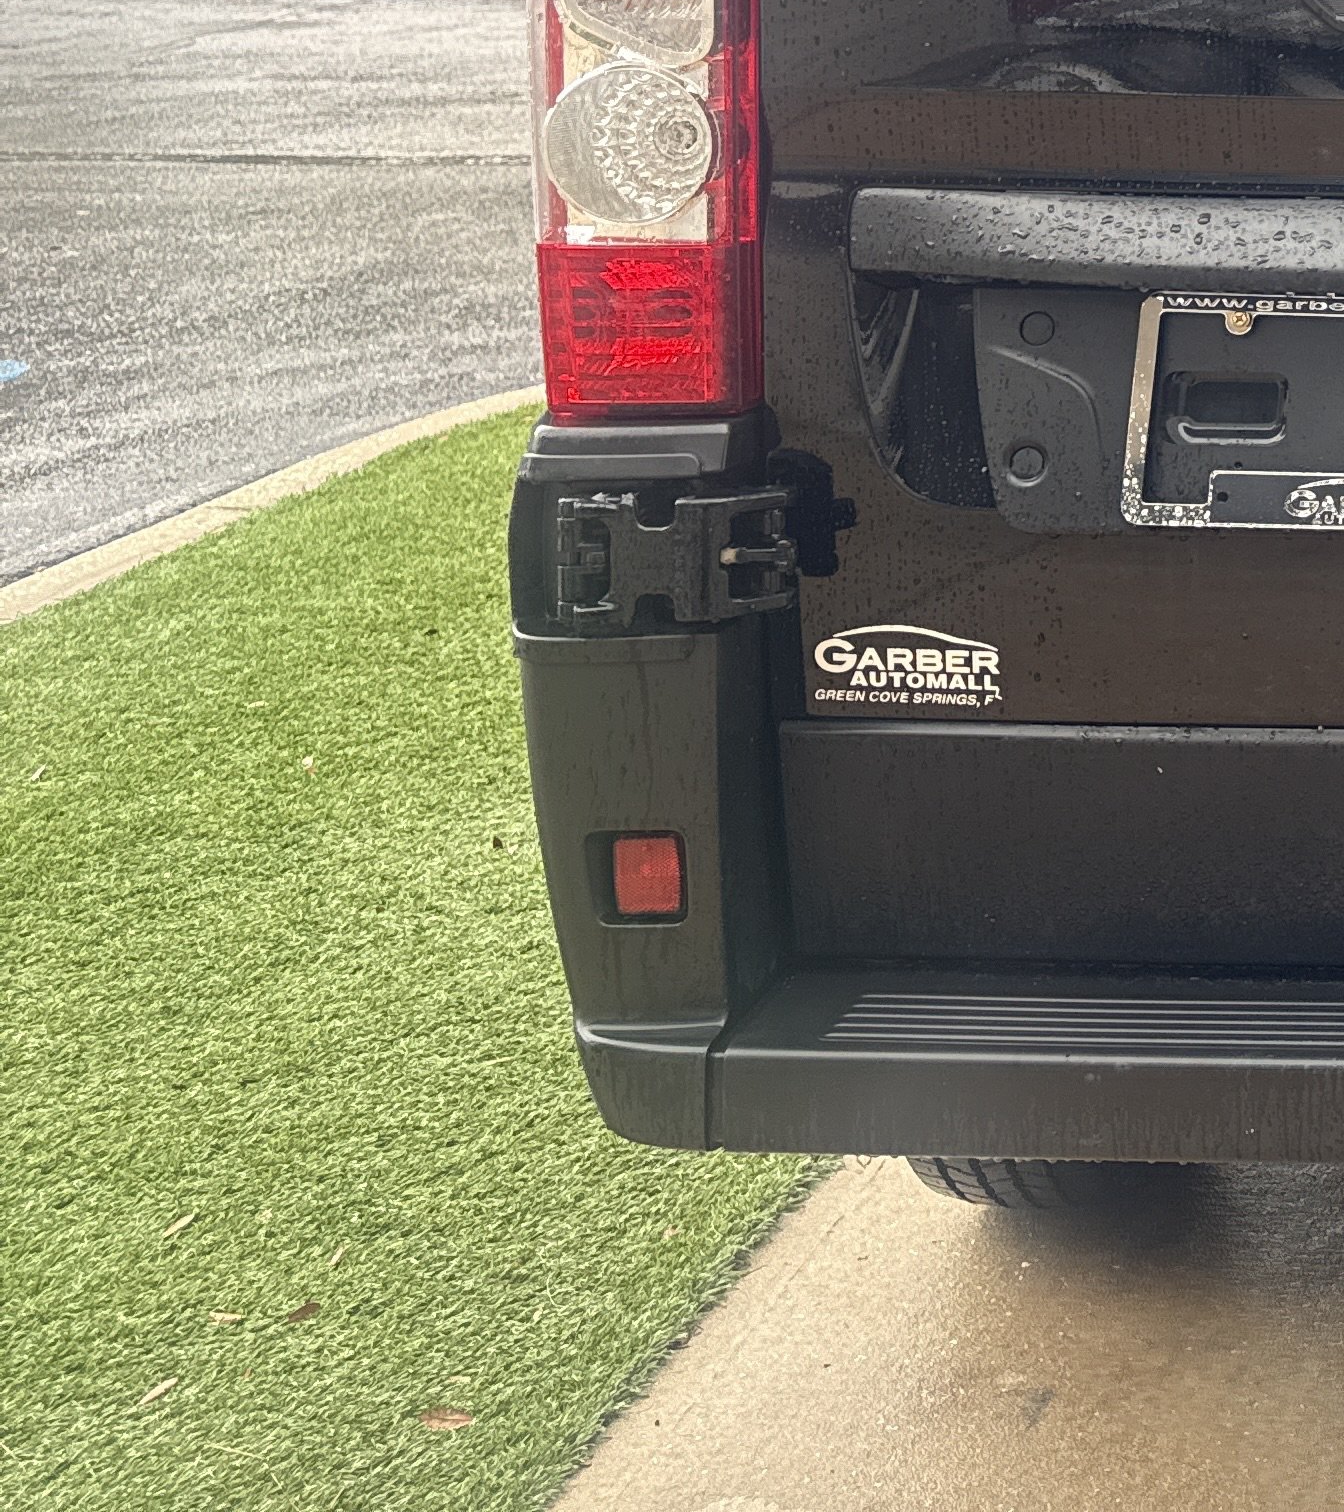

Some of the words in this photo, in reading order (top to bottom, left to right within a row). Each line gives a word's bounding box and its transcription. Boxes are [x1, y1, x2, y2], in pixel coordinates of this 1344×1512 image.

[814, 638, 1000, 675] GARBER
[849, 670, 999, 691] AUTOMALL
[814, 688, 865, 703] GREEN
[869, 690, 909, 704] COVE
[912, 691, 981, 709] SPRINGS,
